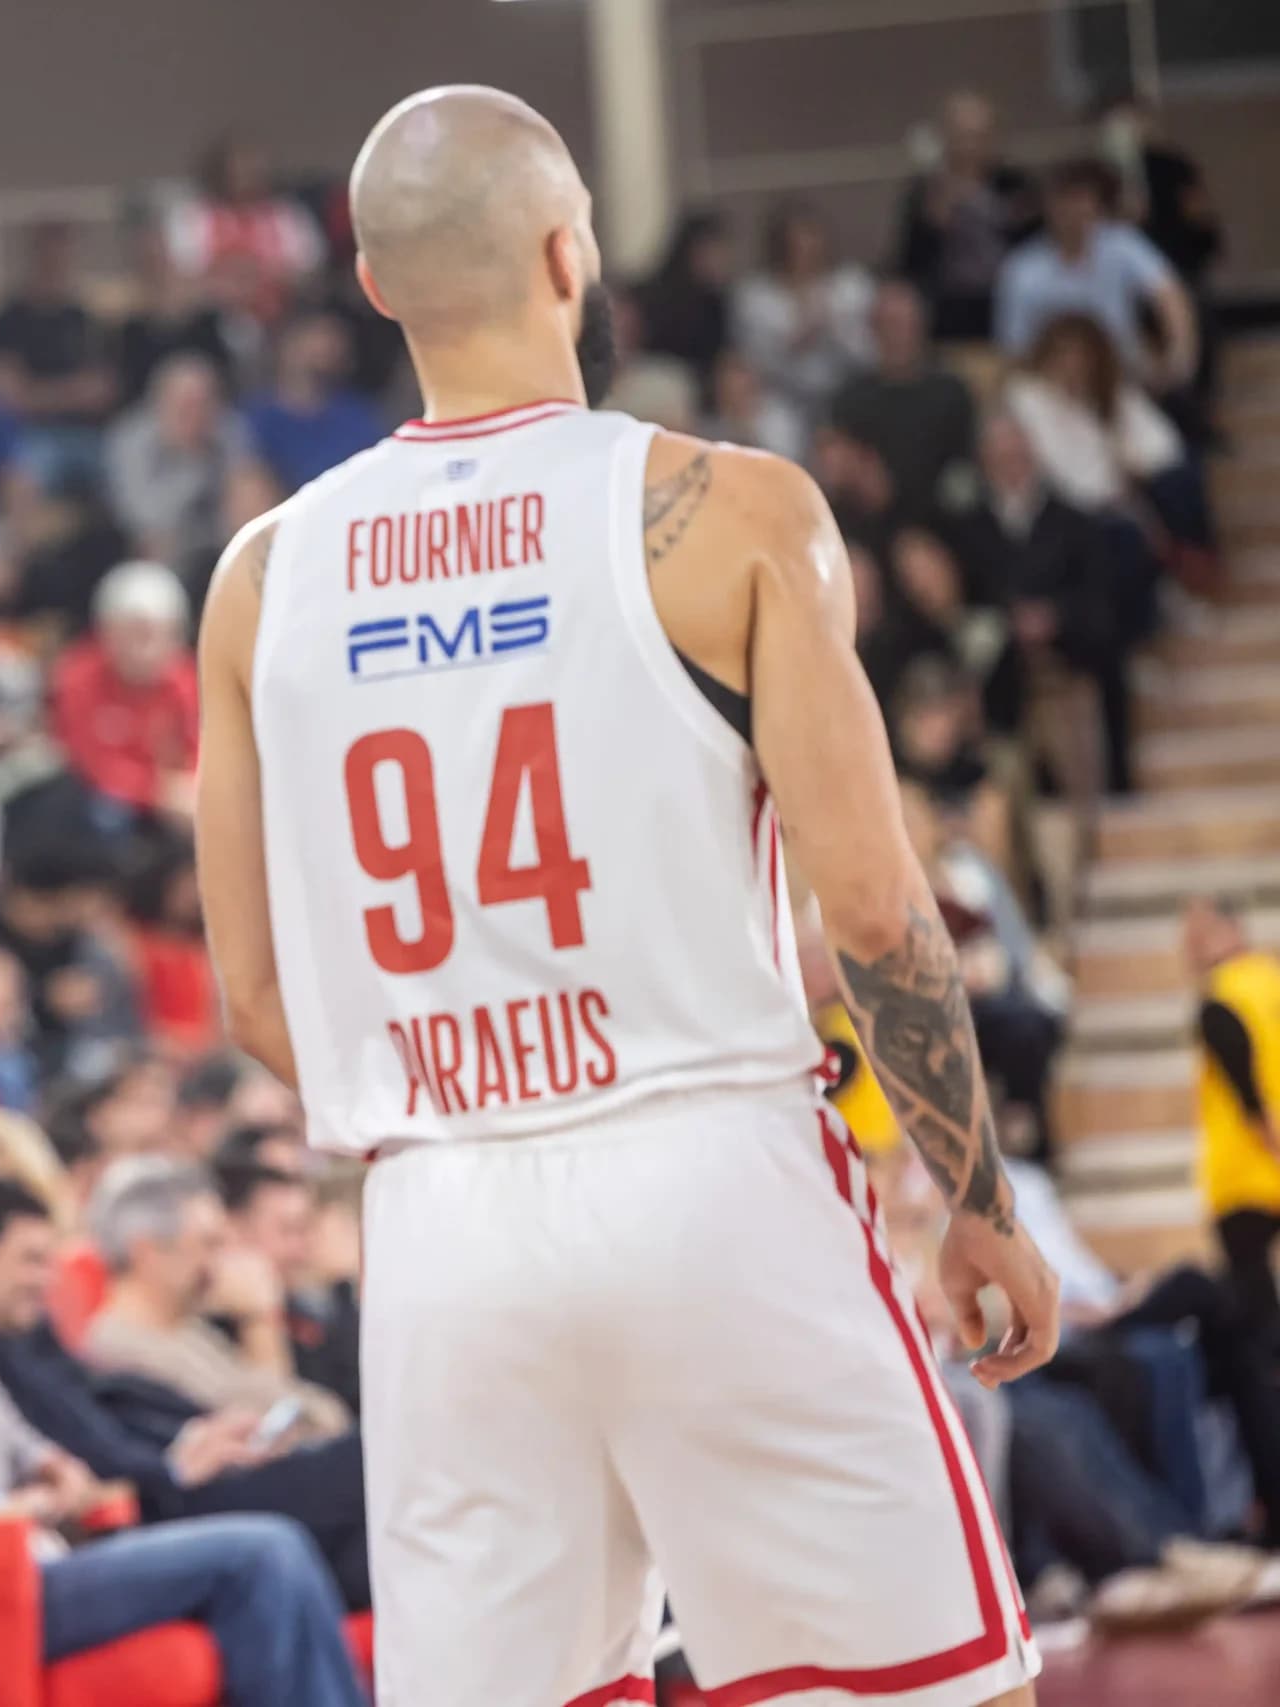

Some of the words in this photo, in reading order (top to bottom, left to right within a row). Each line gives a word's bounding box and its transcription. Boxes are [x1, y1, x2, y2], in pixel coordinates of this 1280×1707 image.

[347, 491, 545, 593] FOURNIER
[348, 595, 550, 674] FMS
[343, 701, 593, 975] 94
